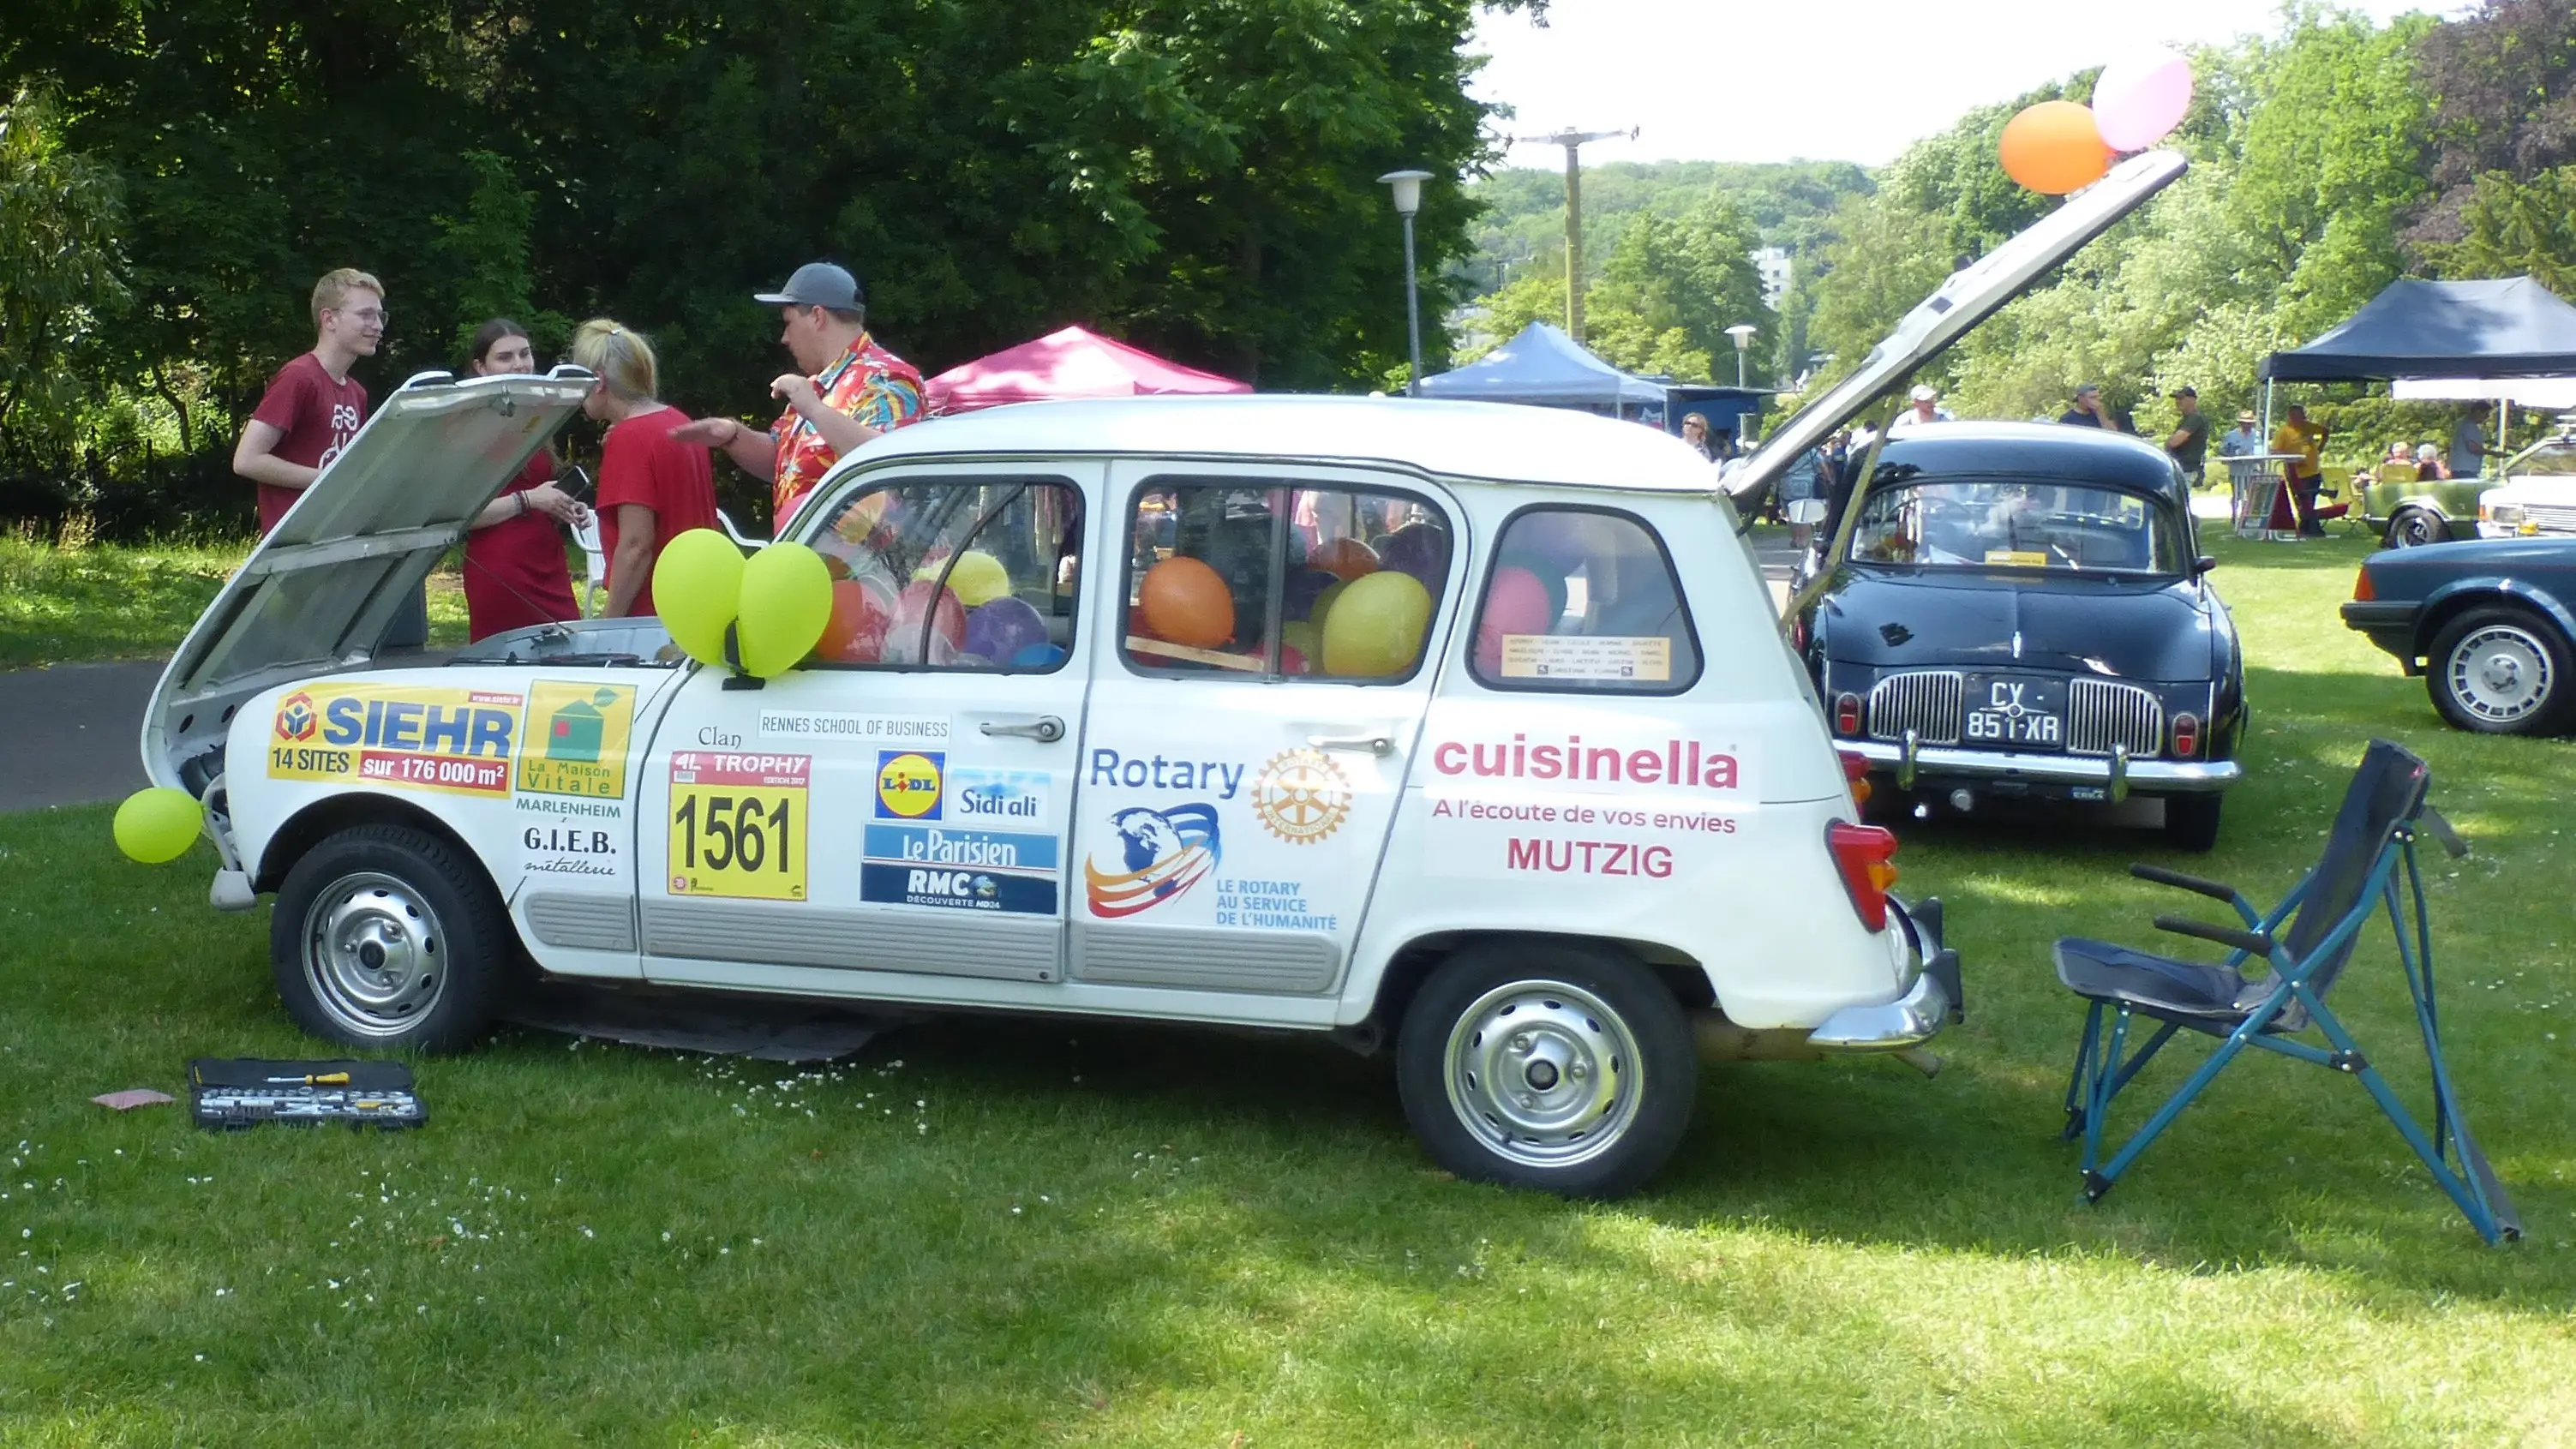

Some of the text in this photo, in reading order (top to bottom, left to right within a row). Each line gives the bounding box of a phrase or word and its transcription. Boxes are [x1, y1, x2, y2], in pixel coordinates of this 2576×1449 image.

[323, 698, 514, 758] SIEHR
[698, 726, 742, 750] Clan
[762, 716, 949, 738] RENNES SCHOOL OF BUSINESS
[273, 748, 350, 773] 14 SITES
[363, 758, 394, 775] sur
[401, 758, 434, 778] 176
[439, 761, 475, 783] 000
[528, 760, 610, 778] La Maison
[675, 753, 806, 774] 4L TROPHY
[1434, 733, 1738, 789] cuisinella
[528, 772, 610, 794] Vitale
[1090, 748, 1245, 799] Rotary
[516, 797, 621, 818] MARLENHEIM
[960, 788, 1037, 817] Sidi ali
[1432, 799, 1735, 834] A l'écoute de vos envies
[524, 827, 616, 854] G.I.E.B.
[675, 794, 789, 872] 1561
[902, 829, 1016, 867] Le Parisien
[1507, 837, 1673, 878] MUTZIG
[908, 869, 971, 897] RMC
[1217, 879, 1301, 895] LE ROTARY
[1217, 895, 1307, 913] AU SERVICE
[1217, 912, 1337, 931] DE L'HUMANITÉ
